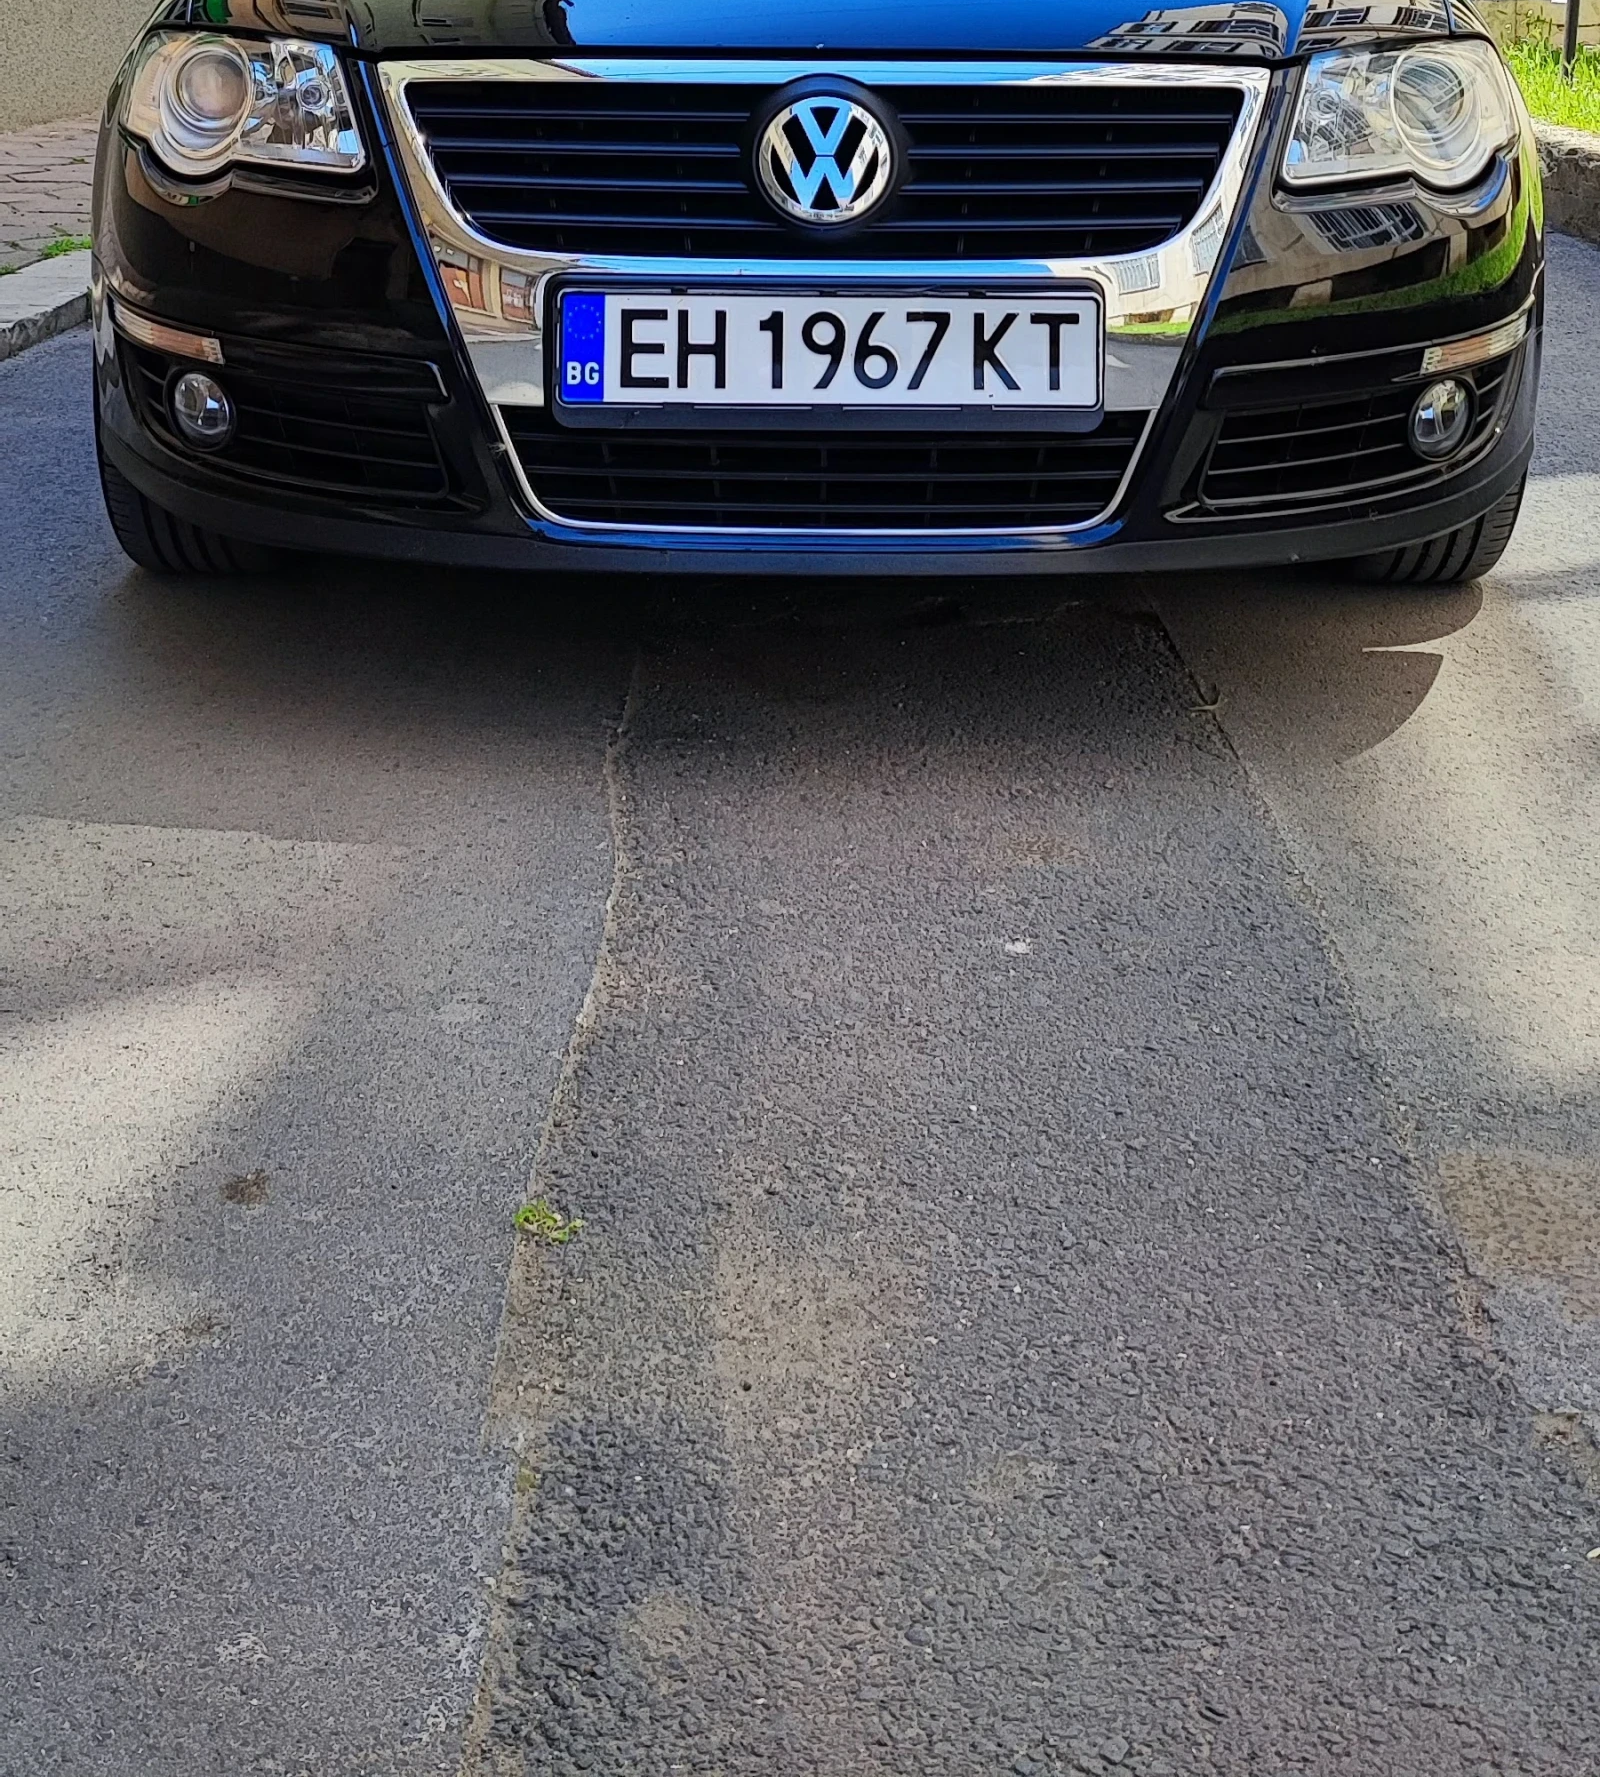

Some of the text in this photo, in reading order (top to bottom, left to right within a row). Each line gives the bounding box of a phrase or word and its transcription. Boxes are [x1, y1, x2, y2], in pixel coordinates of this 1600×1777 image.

[759, 96, 891, 222] VW
[566, 363, 600, 386] BG
[619, 308, 1080, 391] EH 1967 KT
